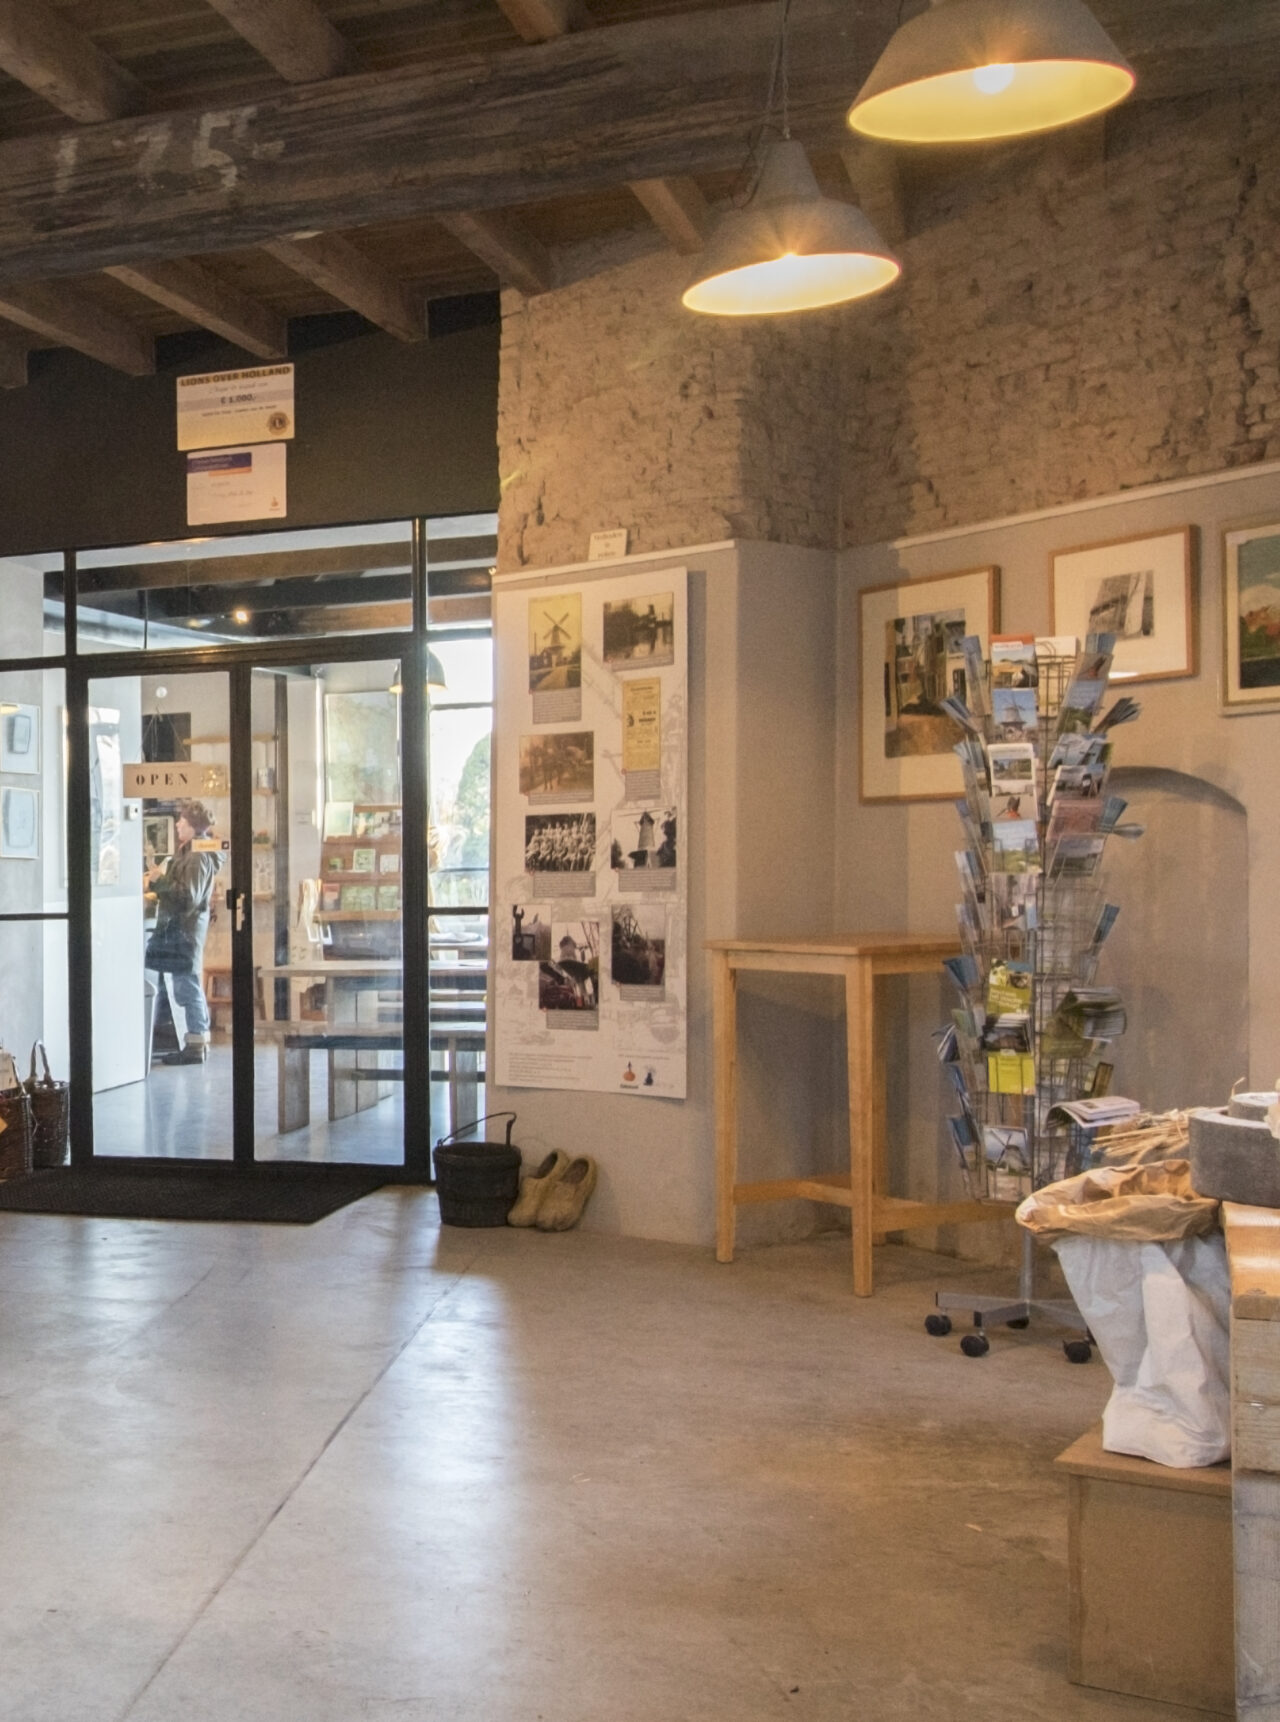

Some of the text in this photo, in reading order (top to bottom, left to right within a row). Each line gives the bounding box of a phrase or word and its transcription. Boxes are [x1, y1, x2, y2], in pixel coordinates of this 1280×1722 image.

[180, 366, 290, 387] LIONS OVER HOLLAND
[136, 772, 189, 786] OPEN
